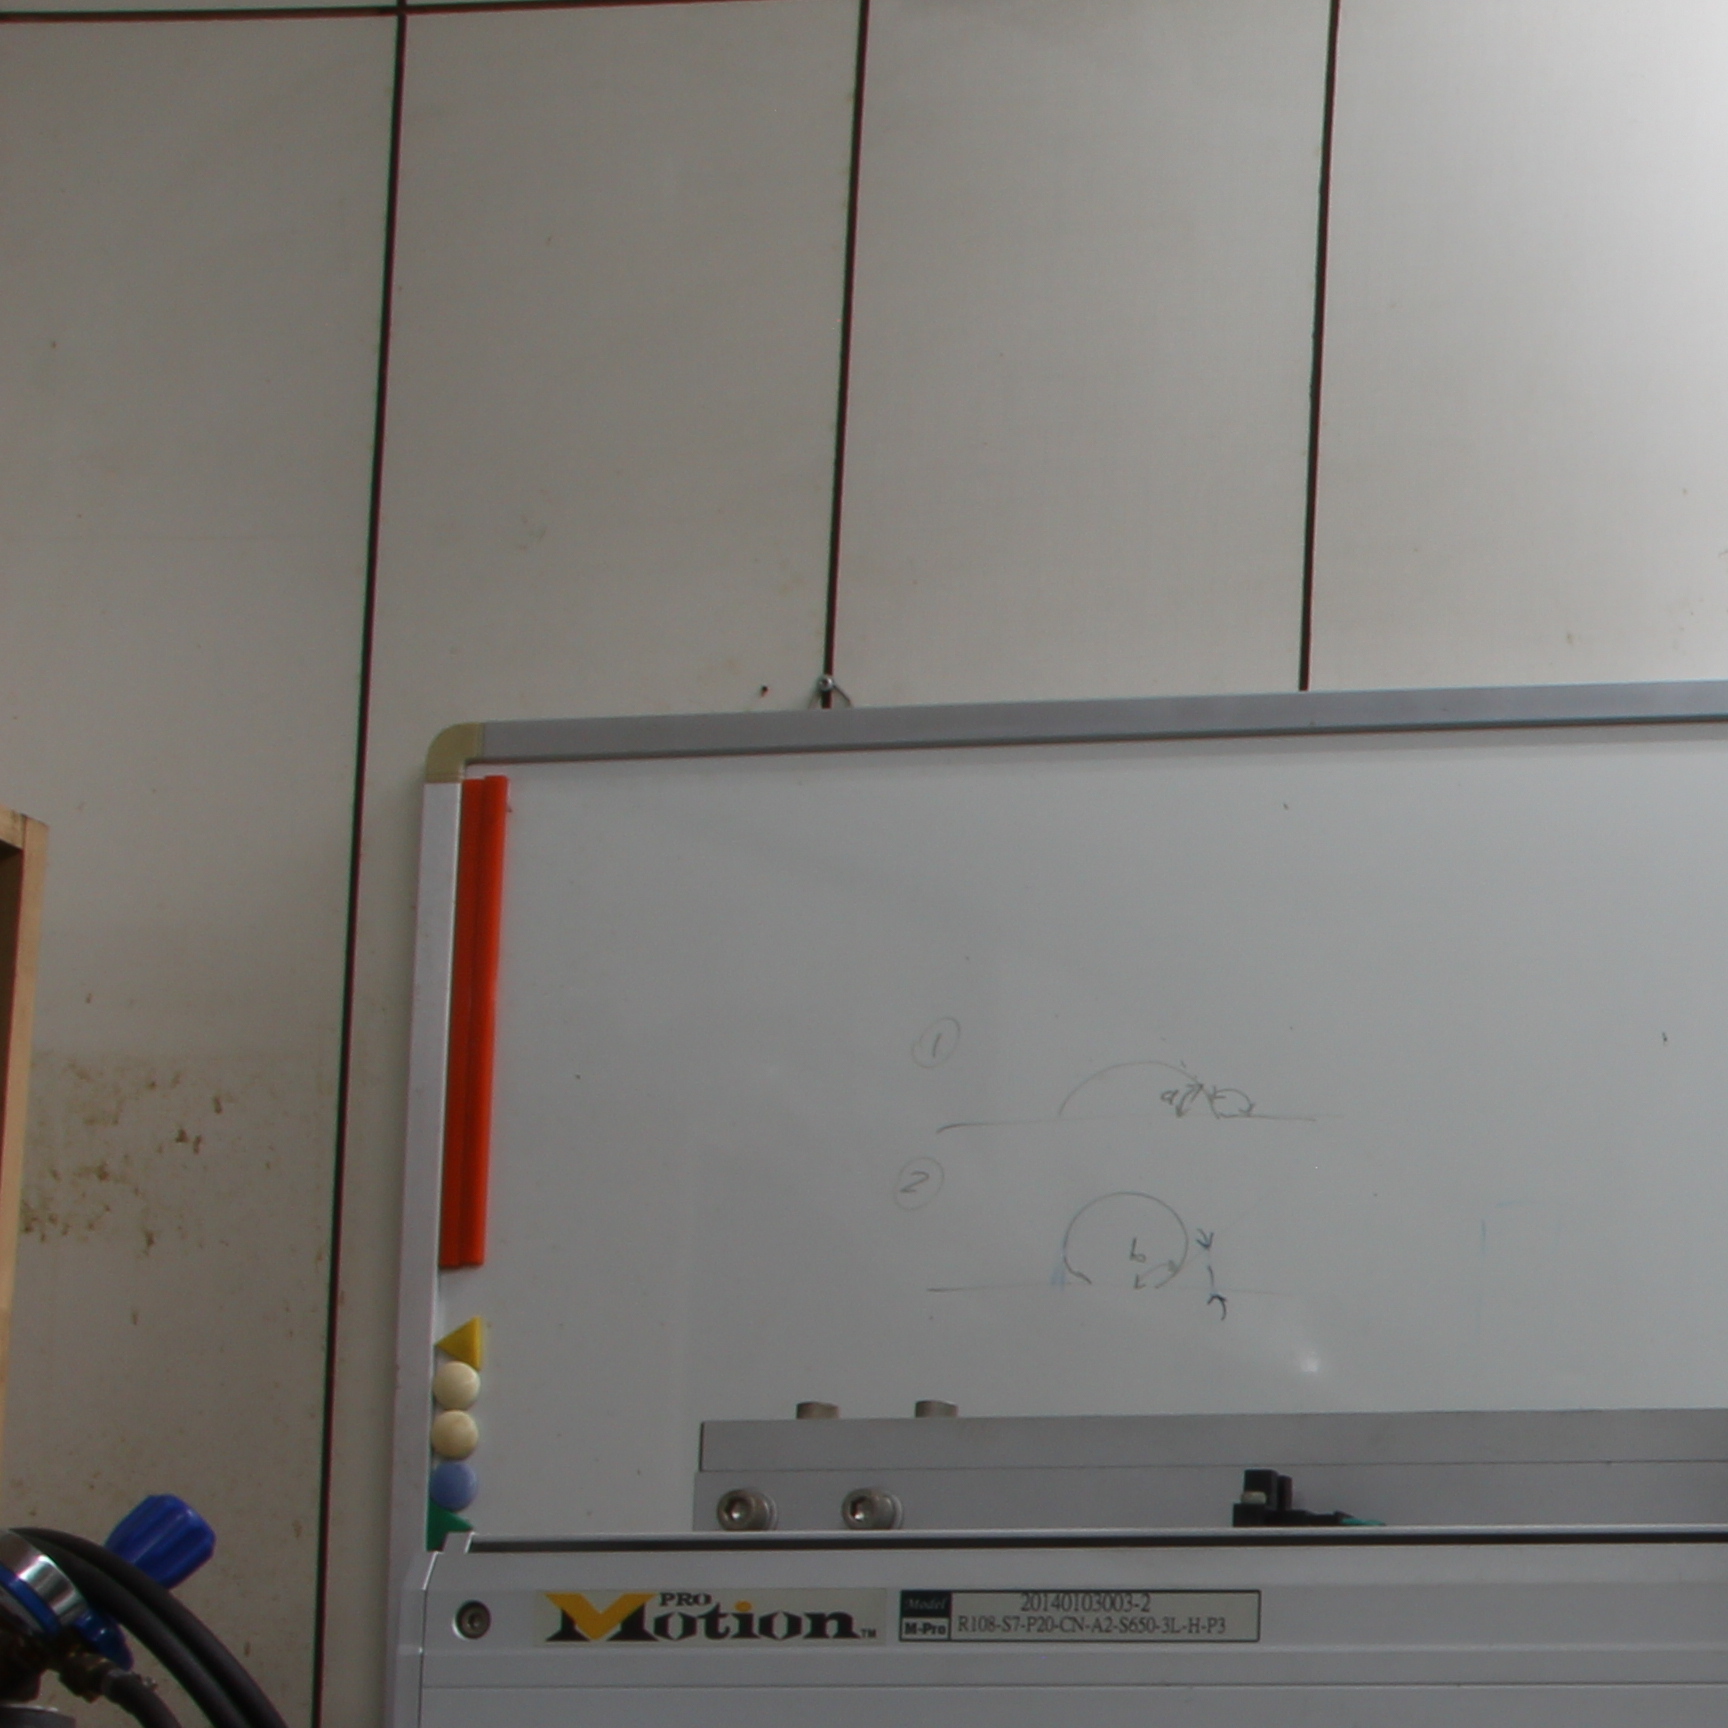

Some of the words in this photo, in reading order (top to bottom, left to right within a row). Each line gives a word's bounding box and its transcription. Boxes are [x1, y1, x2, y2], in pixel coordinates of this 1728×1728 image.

[660, 1592, 712, 1606] PRO
[906, 1597, 948, 1611] Model
[1020, 1593, 1151, 1614] 20140103003-2
[542, 1592, 861, 1641] Motion
[905, 1622, 947, 1636] M-Pro
